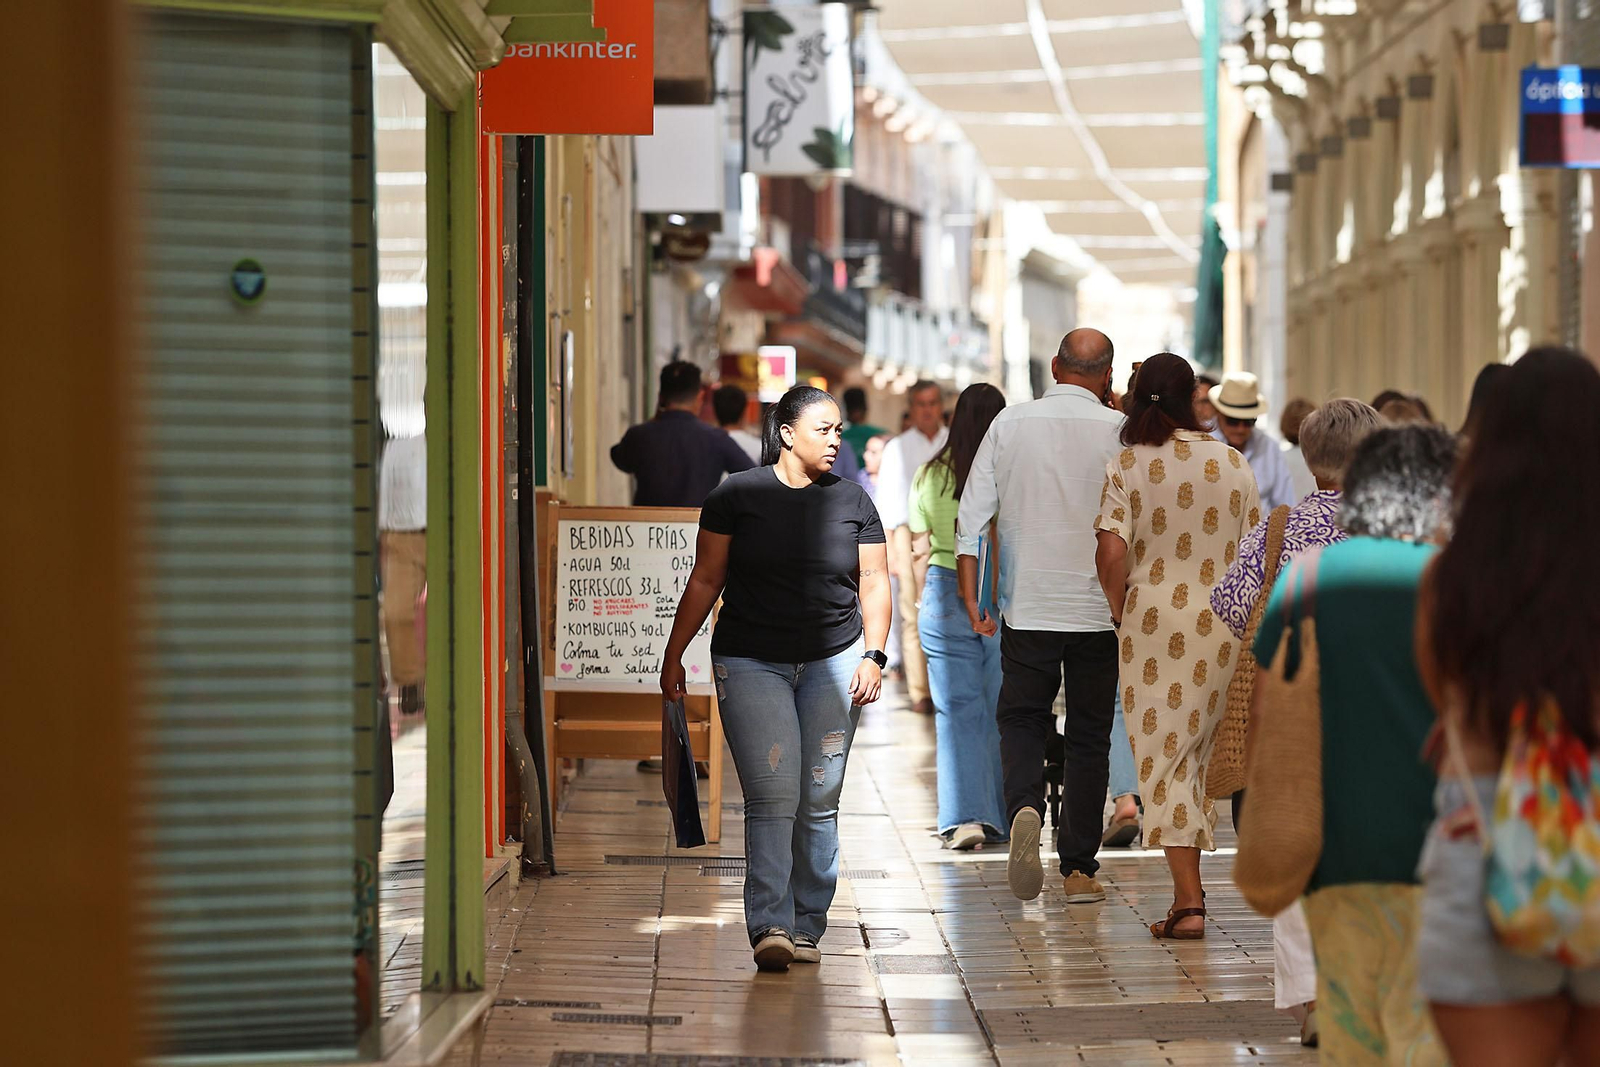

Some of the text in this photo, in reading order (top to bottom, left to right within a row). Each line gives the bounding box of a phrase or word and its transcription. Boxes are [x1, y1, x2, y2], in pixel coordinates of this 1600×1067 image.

[648, 525, 688, 550] FRÍAS
[569, 557, 602, 572] AGUA
[610, 556, 631, 572] 50cl
[569, 577, 632, 597] REFRESCOS
[639, 577, 662, 595] 33cl
[568, 621, 637, 638] KOMBUCHAS
[641, 622, 665, 637] 40cl
[563, 640, 655, 660] Calma tu sed
